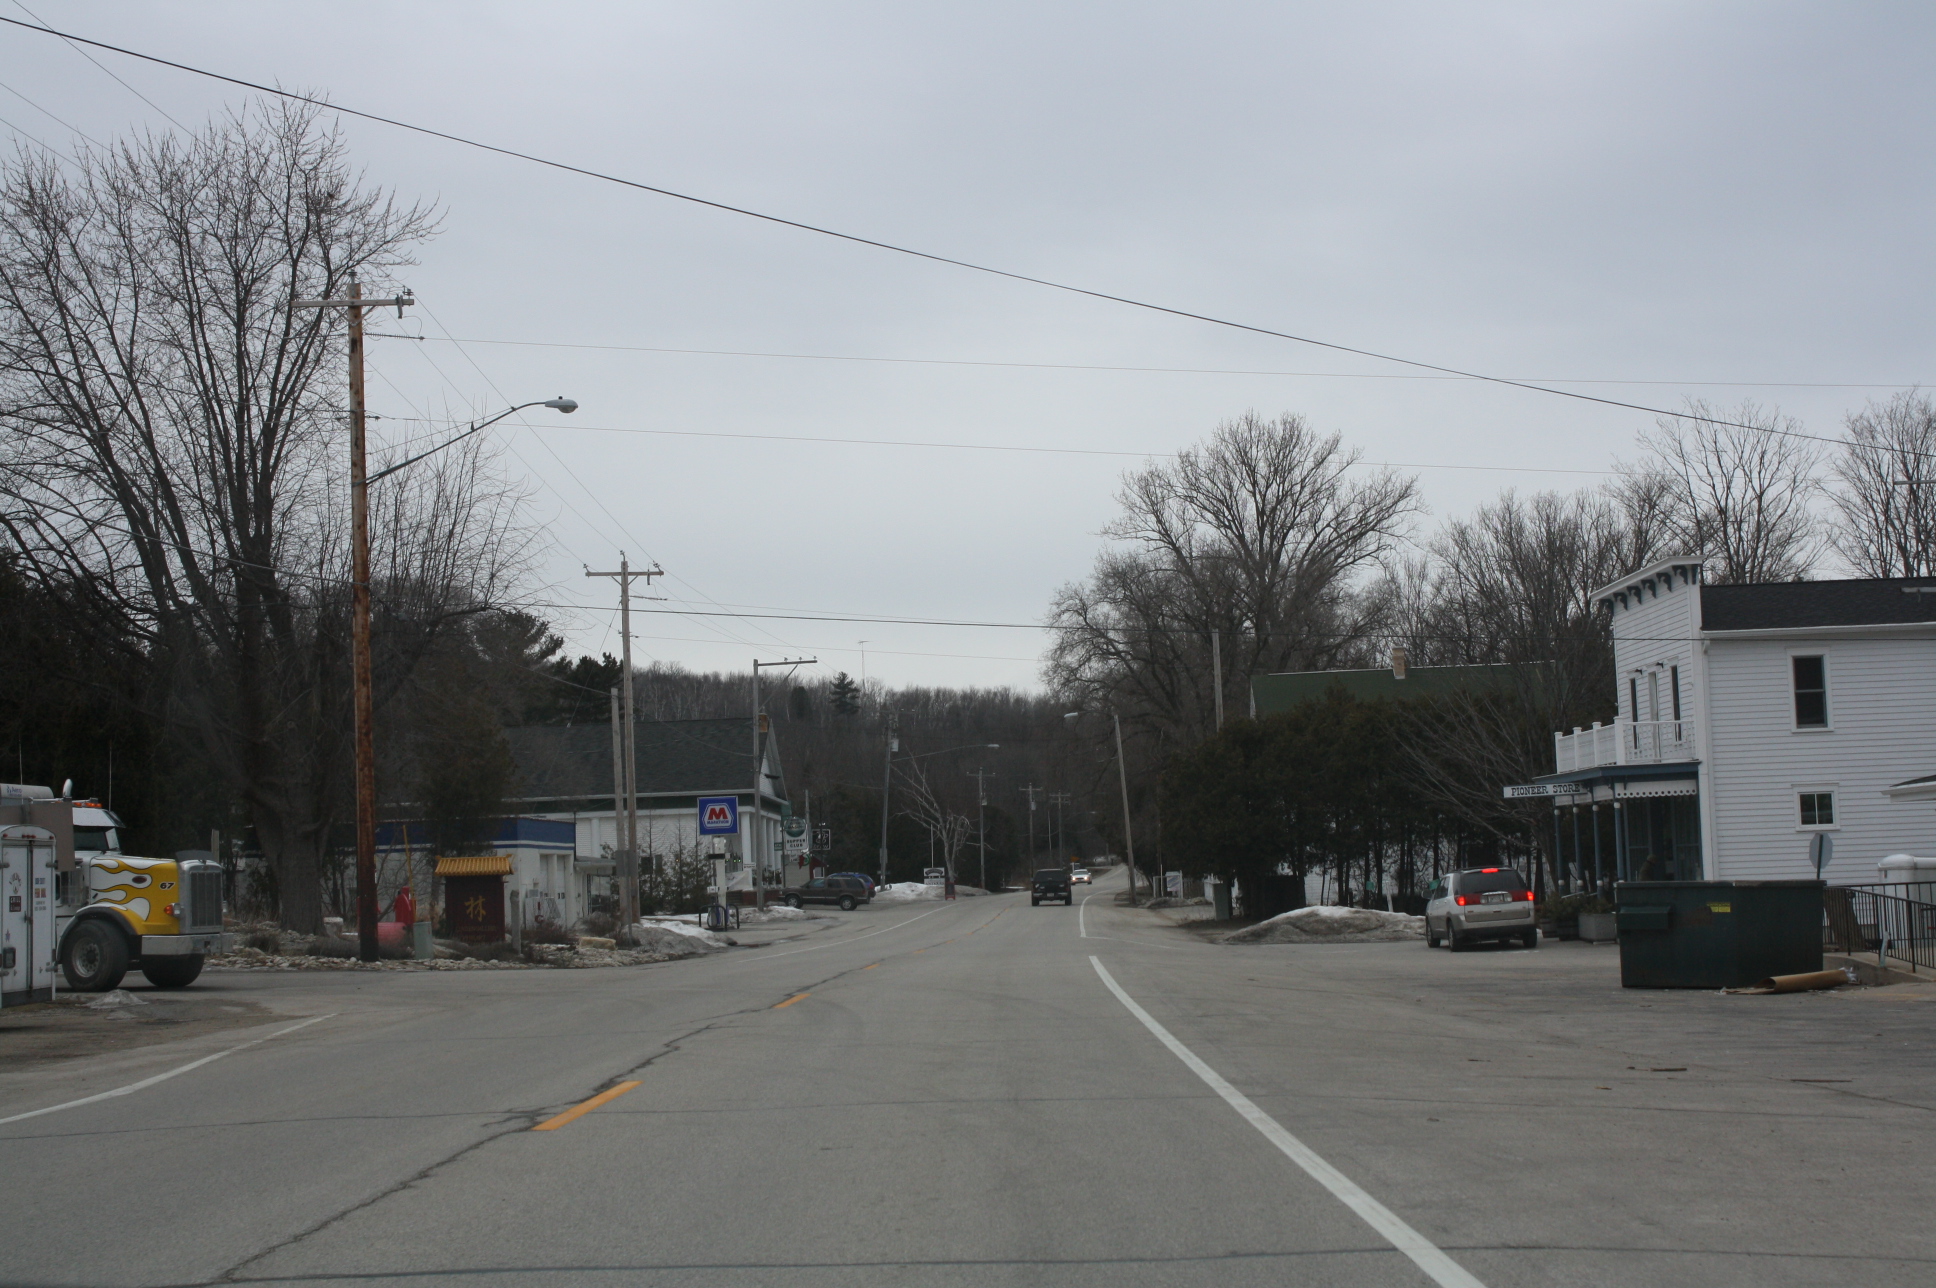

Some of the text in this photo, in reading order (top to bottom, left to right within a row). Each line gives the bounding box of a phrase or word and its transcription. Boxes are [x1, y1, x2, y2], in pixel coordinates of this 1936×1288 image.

[1511, 784, 1580, 797] PIONEER STORE
[708, 807, 728, 821] M
[159, 882, 175, 890] 67
